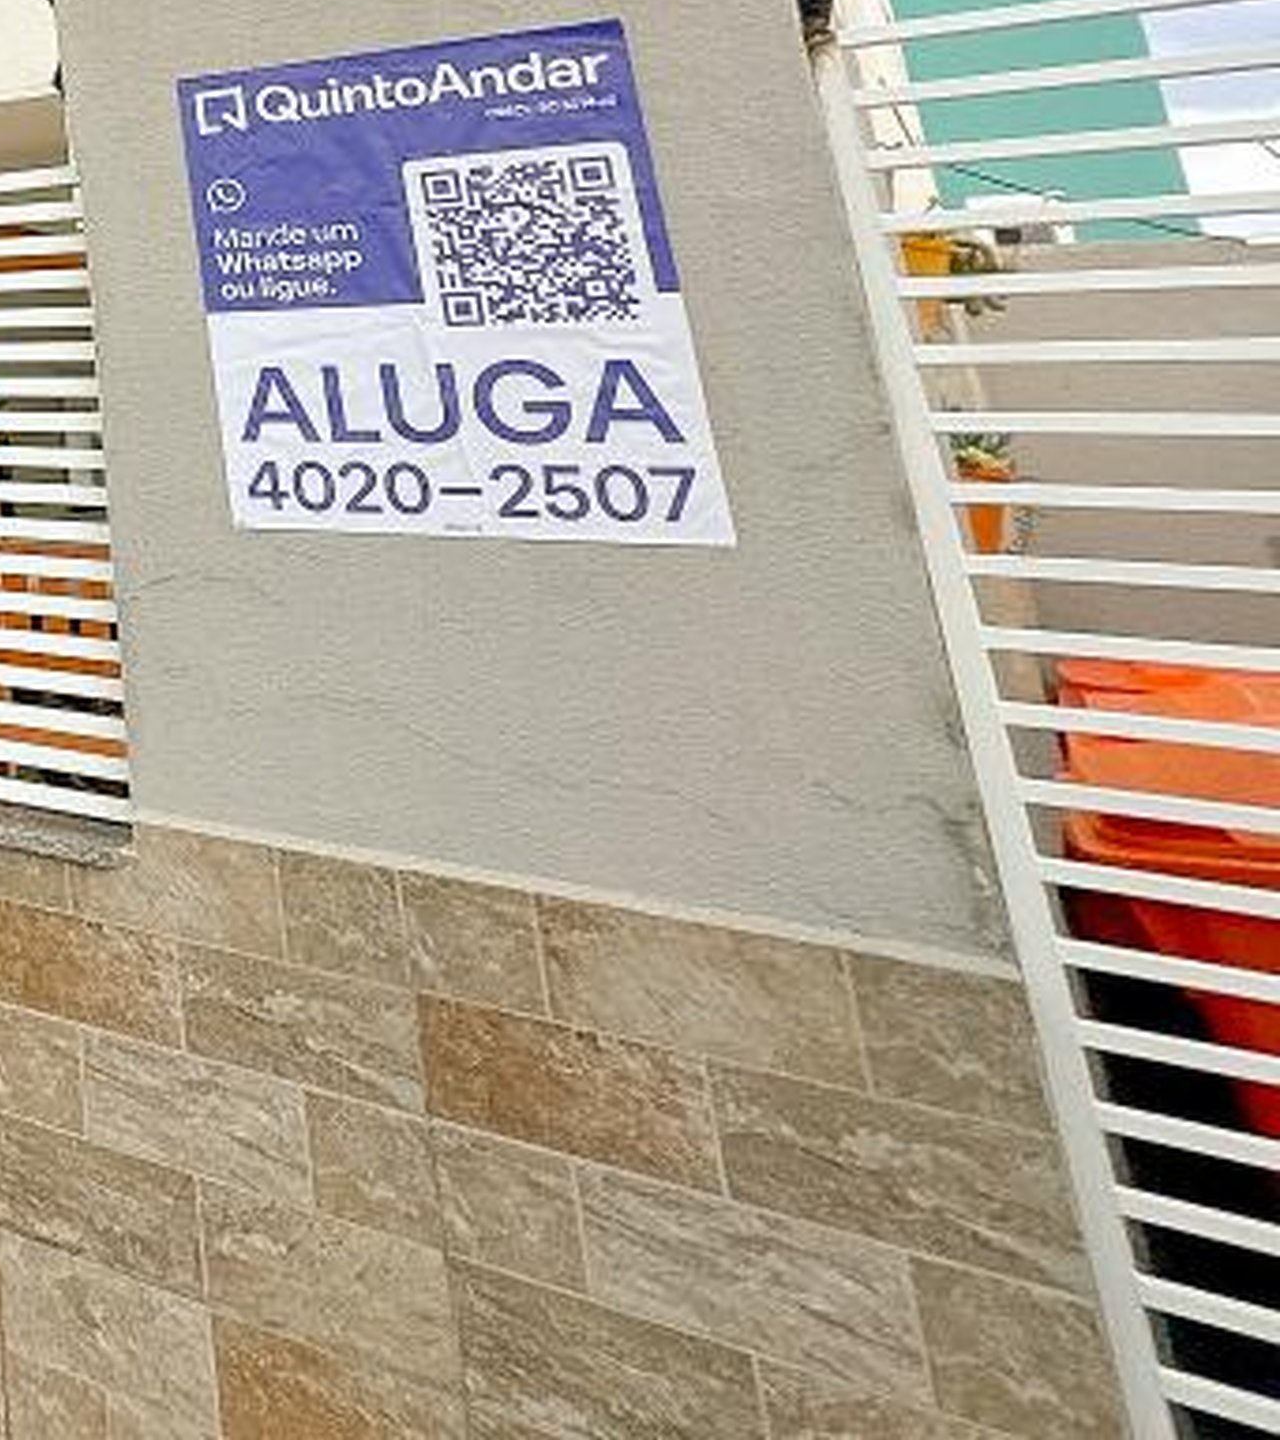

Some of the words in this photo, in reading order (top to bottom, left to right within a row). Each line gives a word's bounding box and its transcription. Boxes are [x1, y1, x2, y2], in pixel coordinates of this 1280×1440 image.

[255, 52, 608, 124] QuintoAndar
[215, 250, 363, 275] Whatsapp
[221, 282, 255, 300] ou
[242, 360, 685, 444] ALUGA
[248, 460, 697, 522] 4020-2507
